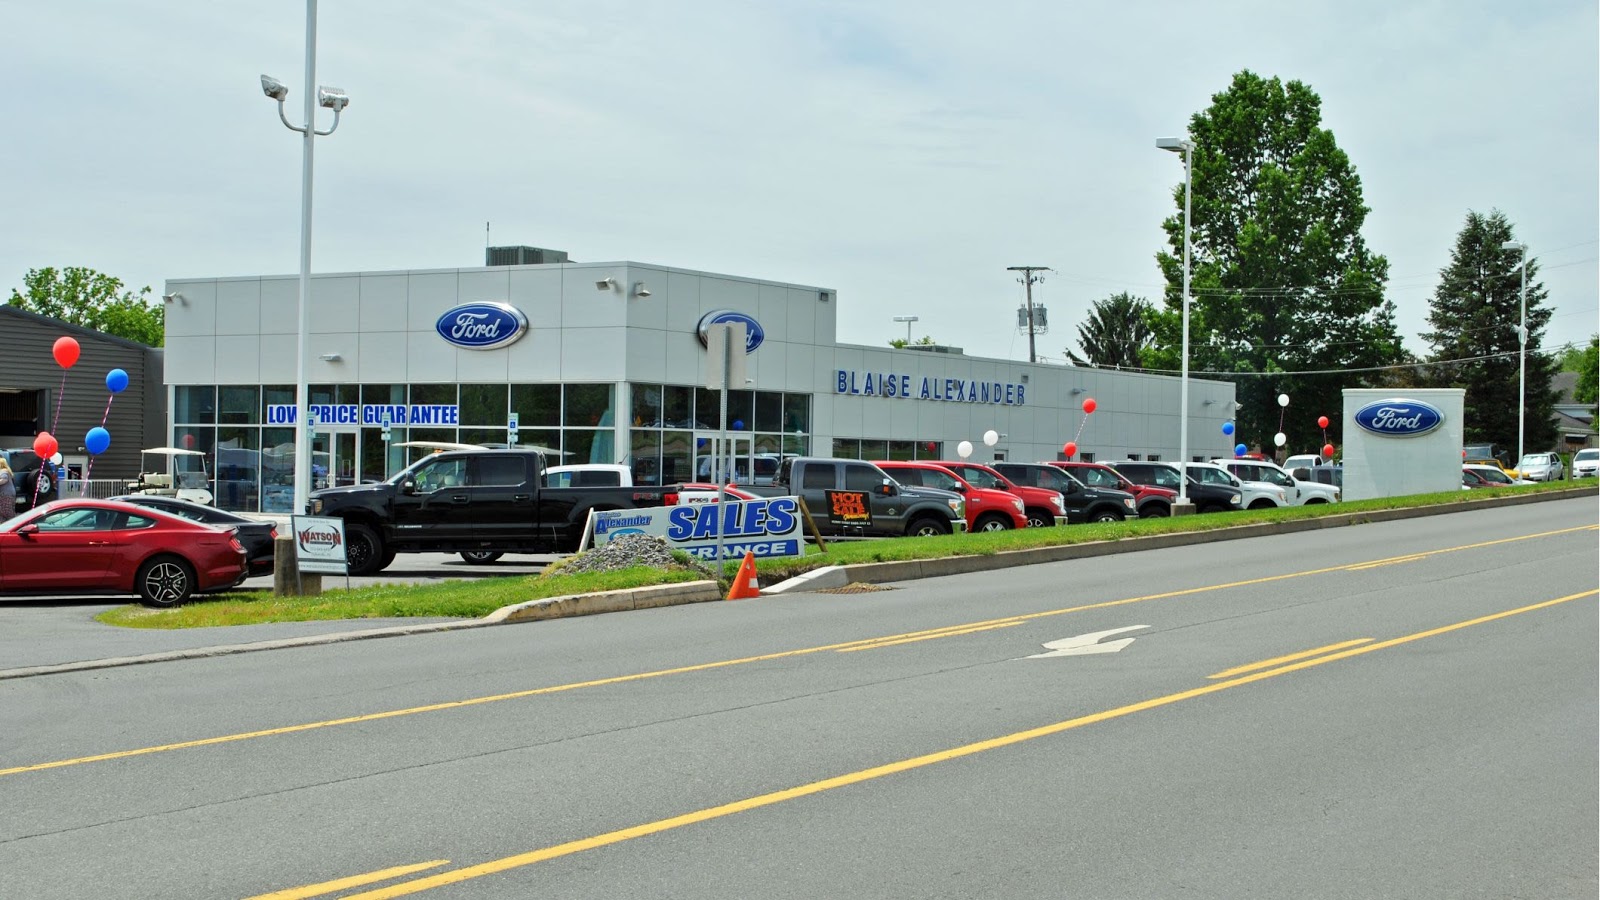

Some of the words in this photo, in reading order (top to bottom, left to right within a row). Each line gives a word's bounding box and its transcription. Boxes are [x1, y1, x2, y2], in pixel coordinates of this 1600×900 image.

[452, 313, 501, 338] Ford
[838, 371, 910, 397] BLAISE
[921, 377, 1025, 405] ALEXANDER
[268, 406, 297, 423] LOW
[311, 406, 357, 423] PRICE
[364, 406, 457, 423] GUARANTEE
[1372, 407, 1422, 429] Ford
[831, 492, 863, 503] HOT
[833, 504, 866, 516] SALE
[595, 515, 653, 534] Alexander
[667, 499, 798, 541] SALES
[298, 531, 342, 545] WATSON
